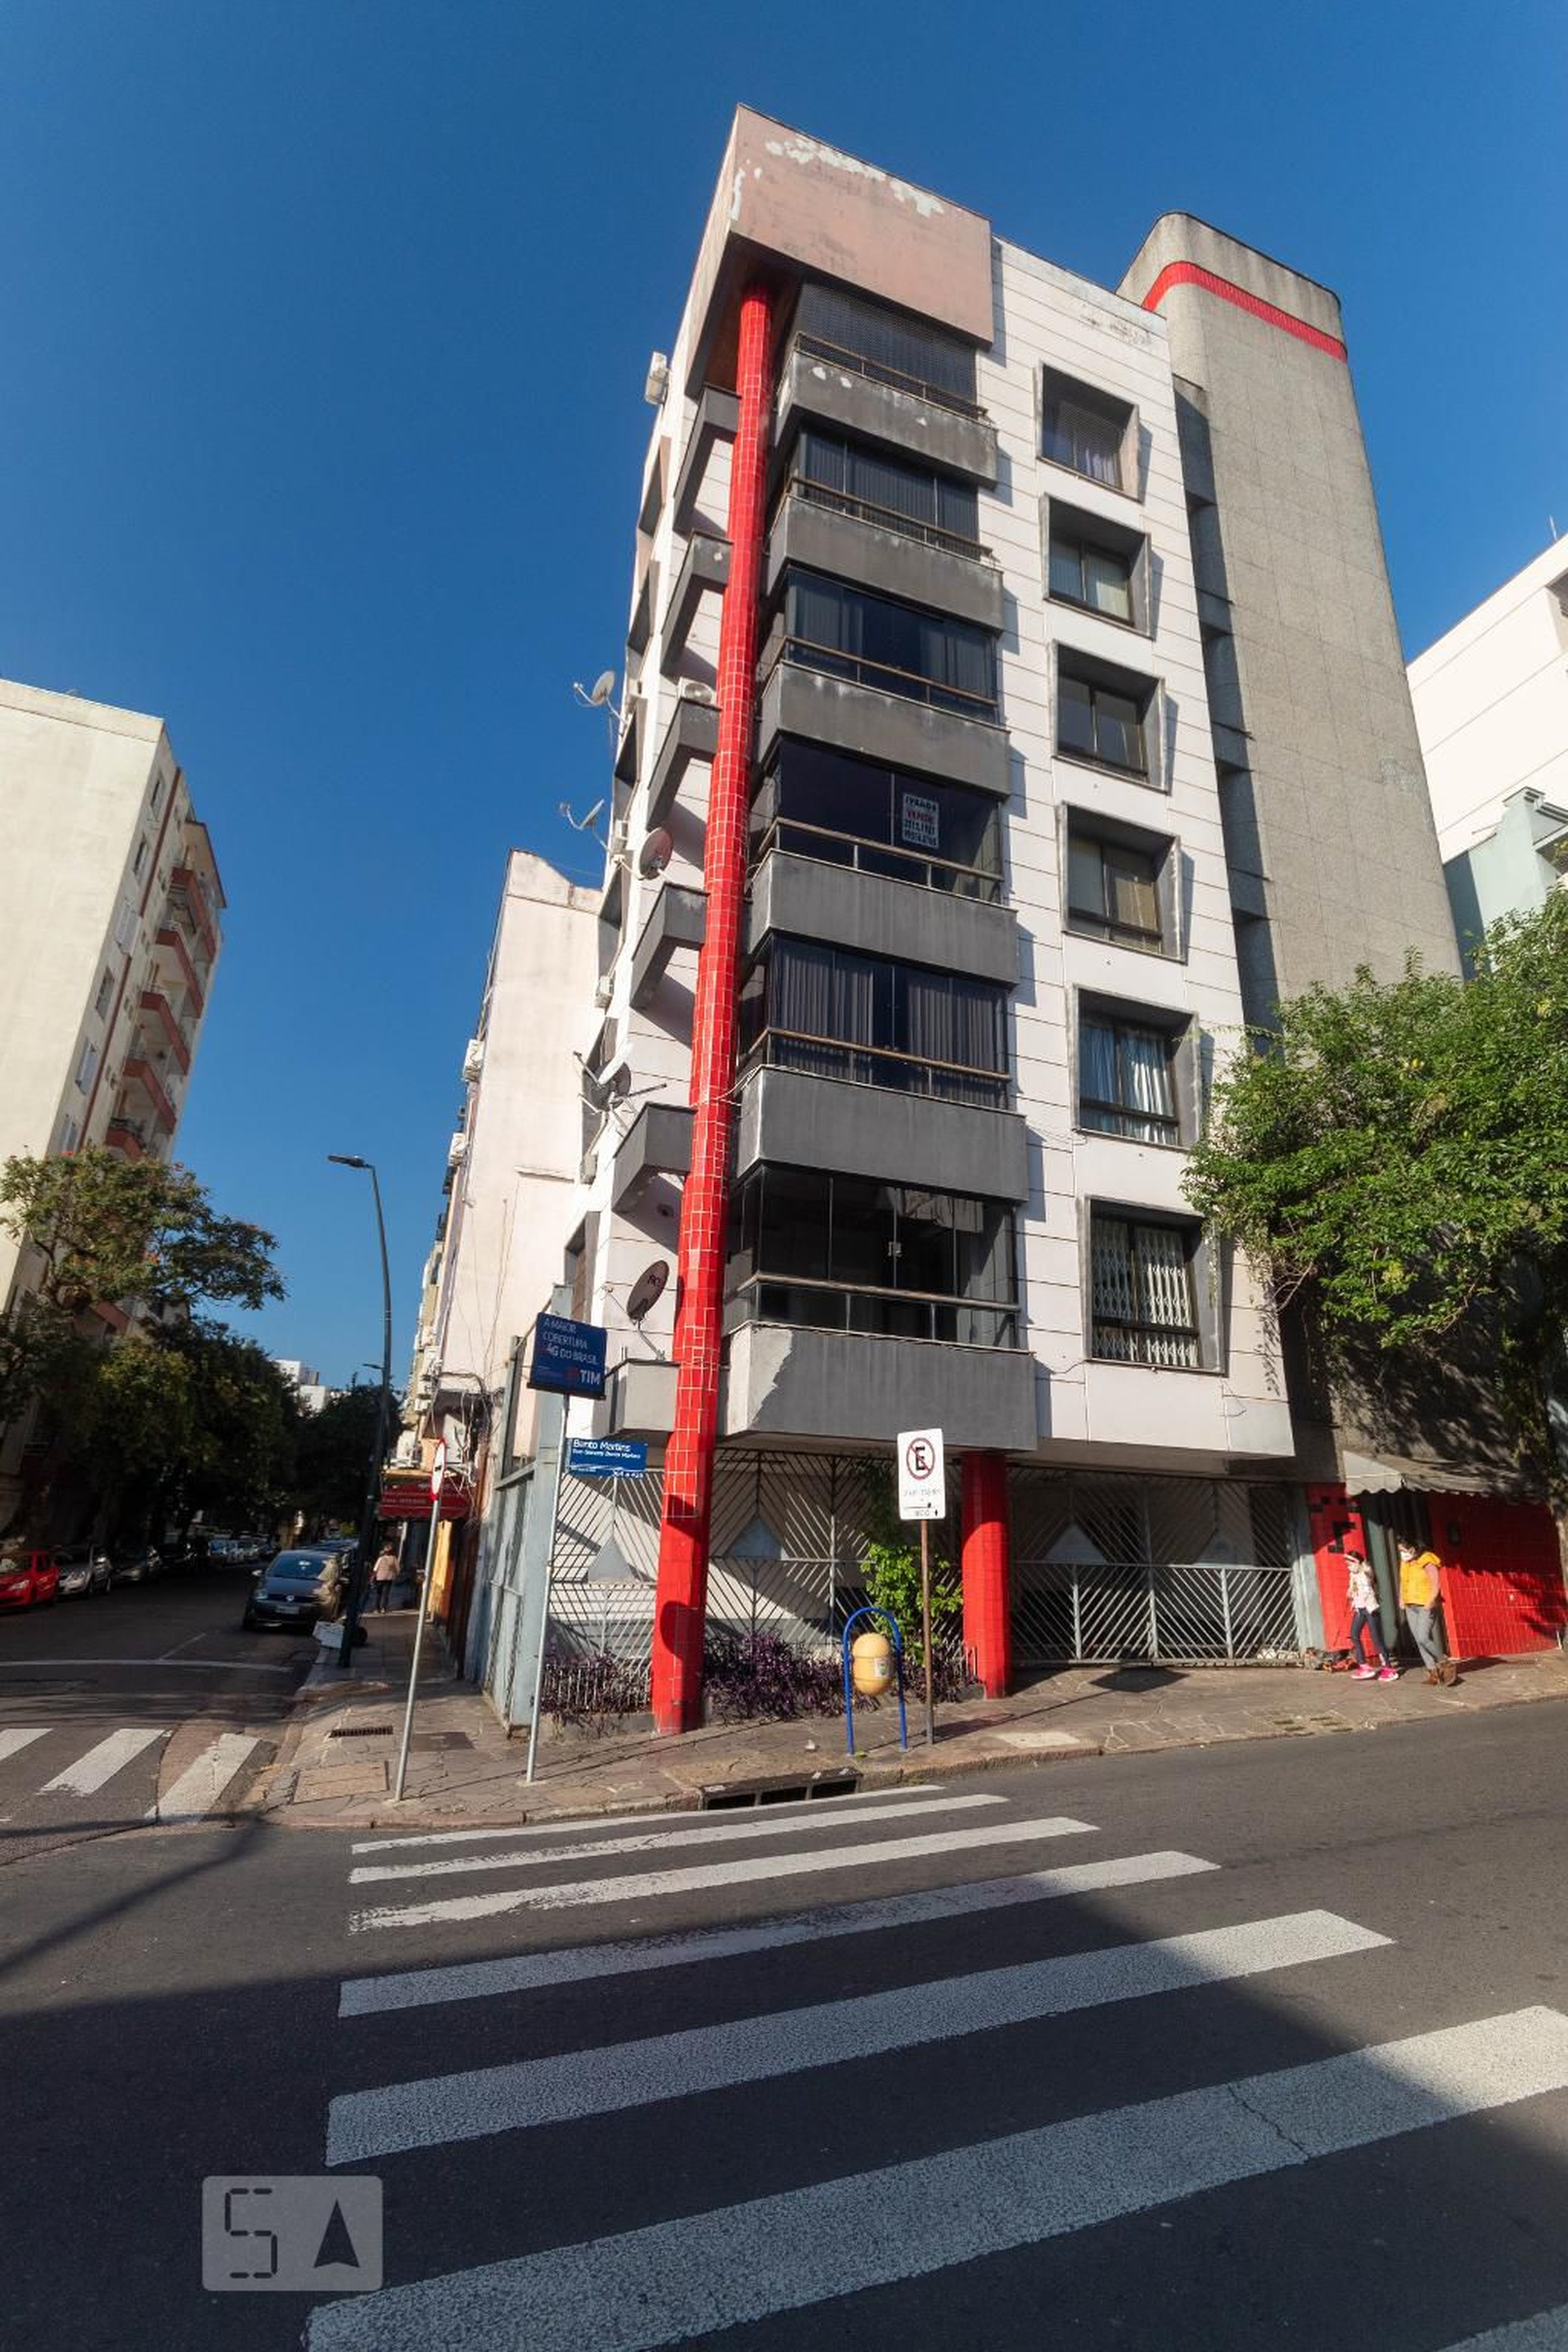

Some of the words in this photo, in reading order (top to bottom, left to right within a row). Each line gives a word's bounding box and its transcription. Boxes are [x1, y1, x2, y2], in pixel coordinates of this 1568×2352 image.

[542, 1331, 588, 1349] COBERTURA
[560, 1348, 572, 1359] DO
[572, 1352, 599, 1365] BRASIL
[580, 1370, 601, 1385] TIM
[600, 1441, 631, 1452] Martins
[915, 1446, 926, 1470] E
